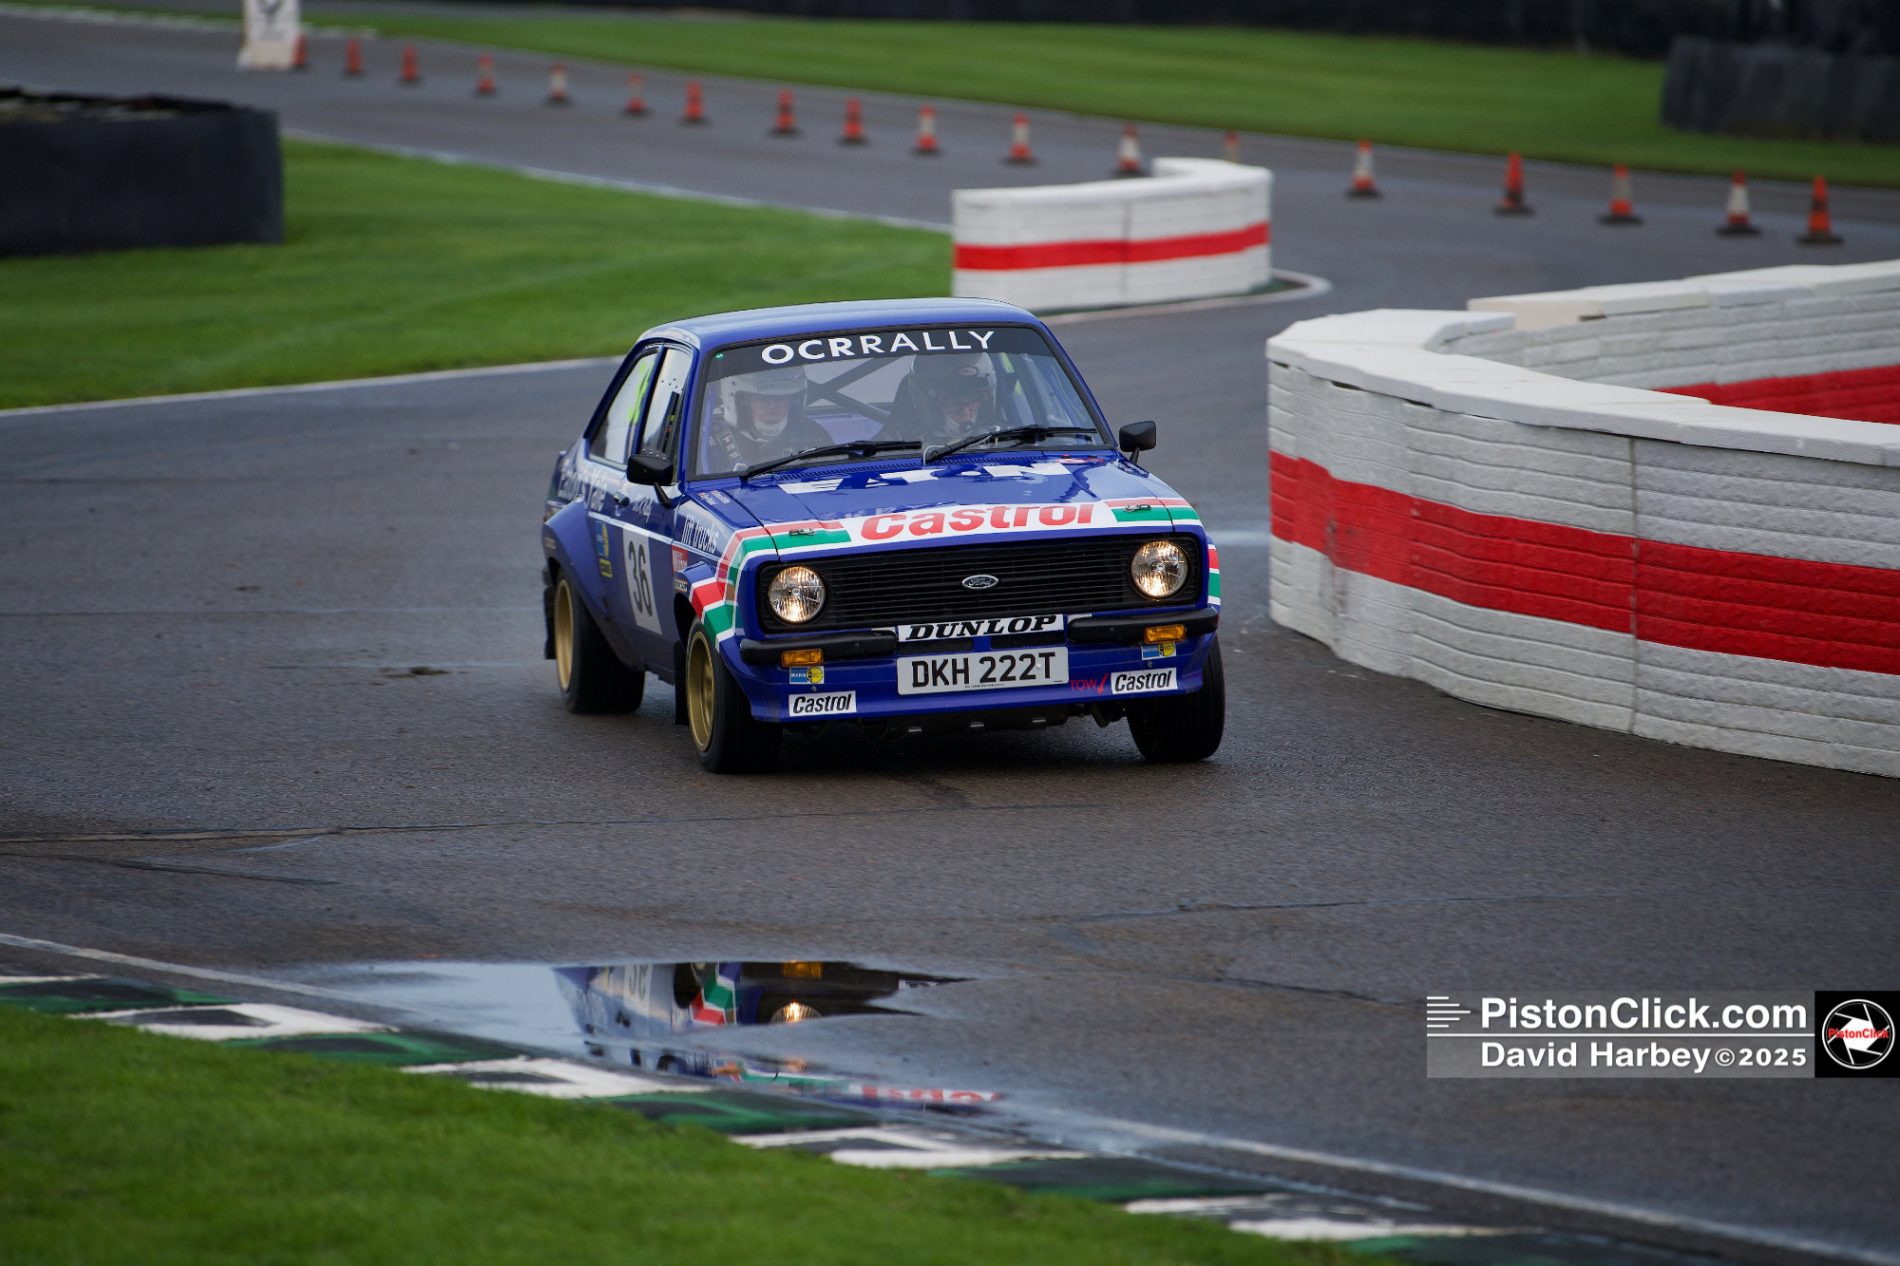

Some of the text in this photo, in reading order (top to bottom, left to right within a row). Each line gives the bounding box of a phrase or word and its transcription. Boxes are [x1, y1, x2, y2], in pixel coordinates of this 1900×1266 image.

[761, 330, 995, 365] OCRRALLY
[860, 503, 1095, 541] Castrol
[629, 540, 653, 617] 36
[905, 615, 1057, 641] DUNLOP
[911, 652, 1056, 688] DKH 222T
[1070, 679, 1097, 691] TOW
[1114, 670, 1173, 692] Castrol
[793, 693, 852, 713] Castrol
